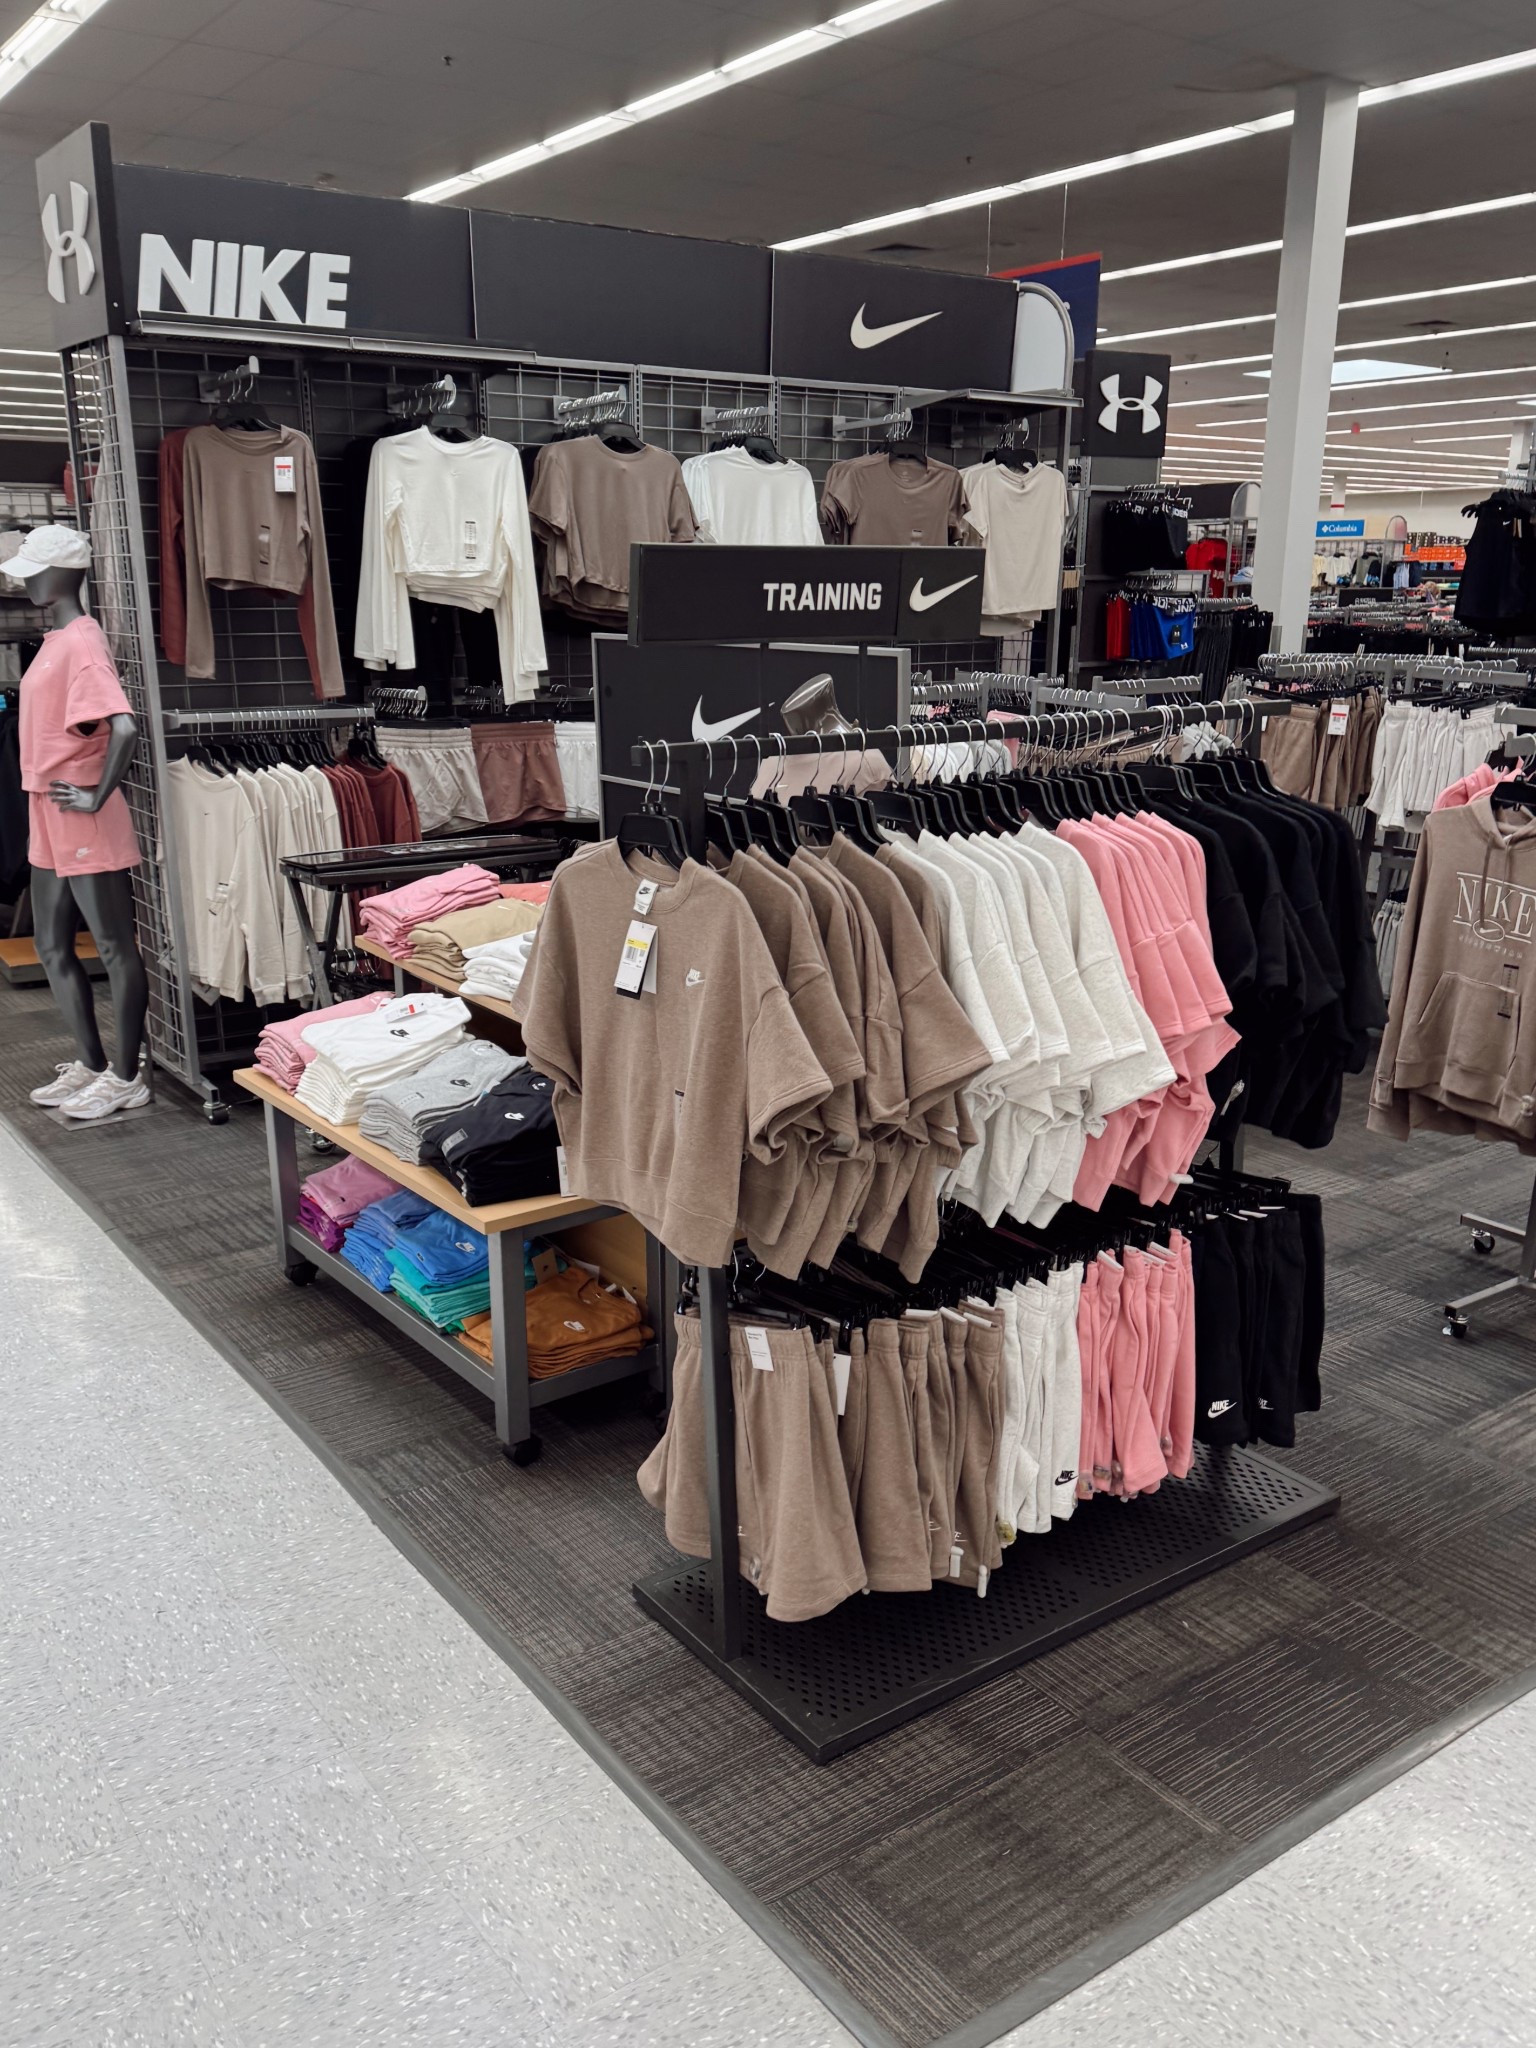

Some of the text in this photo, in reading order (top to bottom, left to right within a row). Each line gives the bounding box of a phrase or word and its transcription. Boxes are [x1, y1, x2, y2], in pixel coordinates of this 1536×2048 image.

[137, 233, 350, 329] NIKE
[1328, 524, 1357, 533] Columbia
[763, 582, 882, 611] TRAINING
[1211, 1399, 1230, 1411] NIKE
